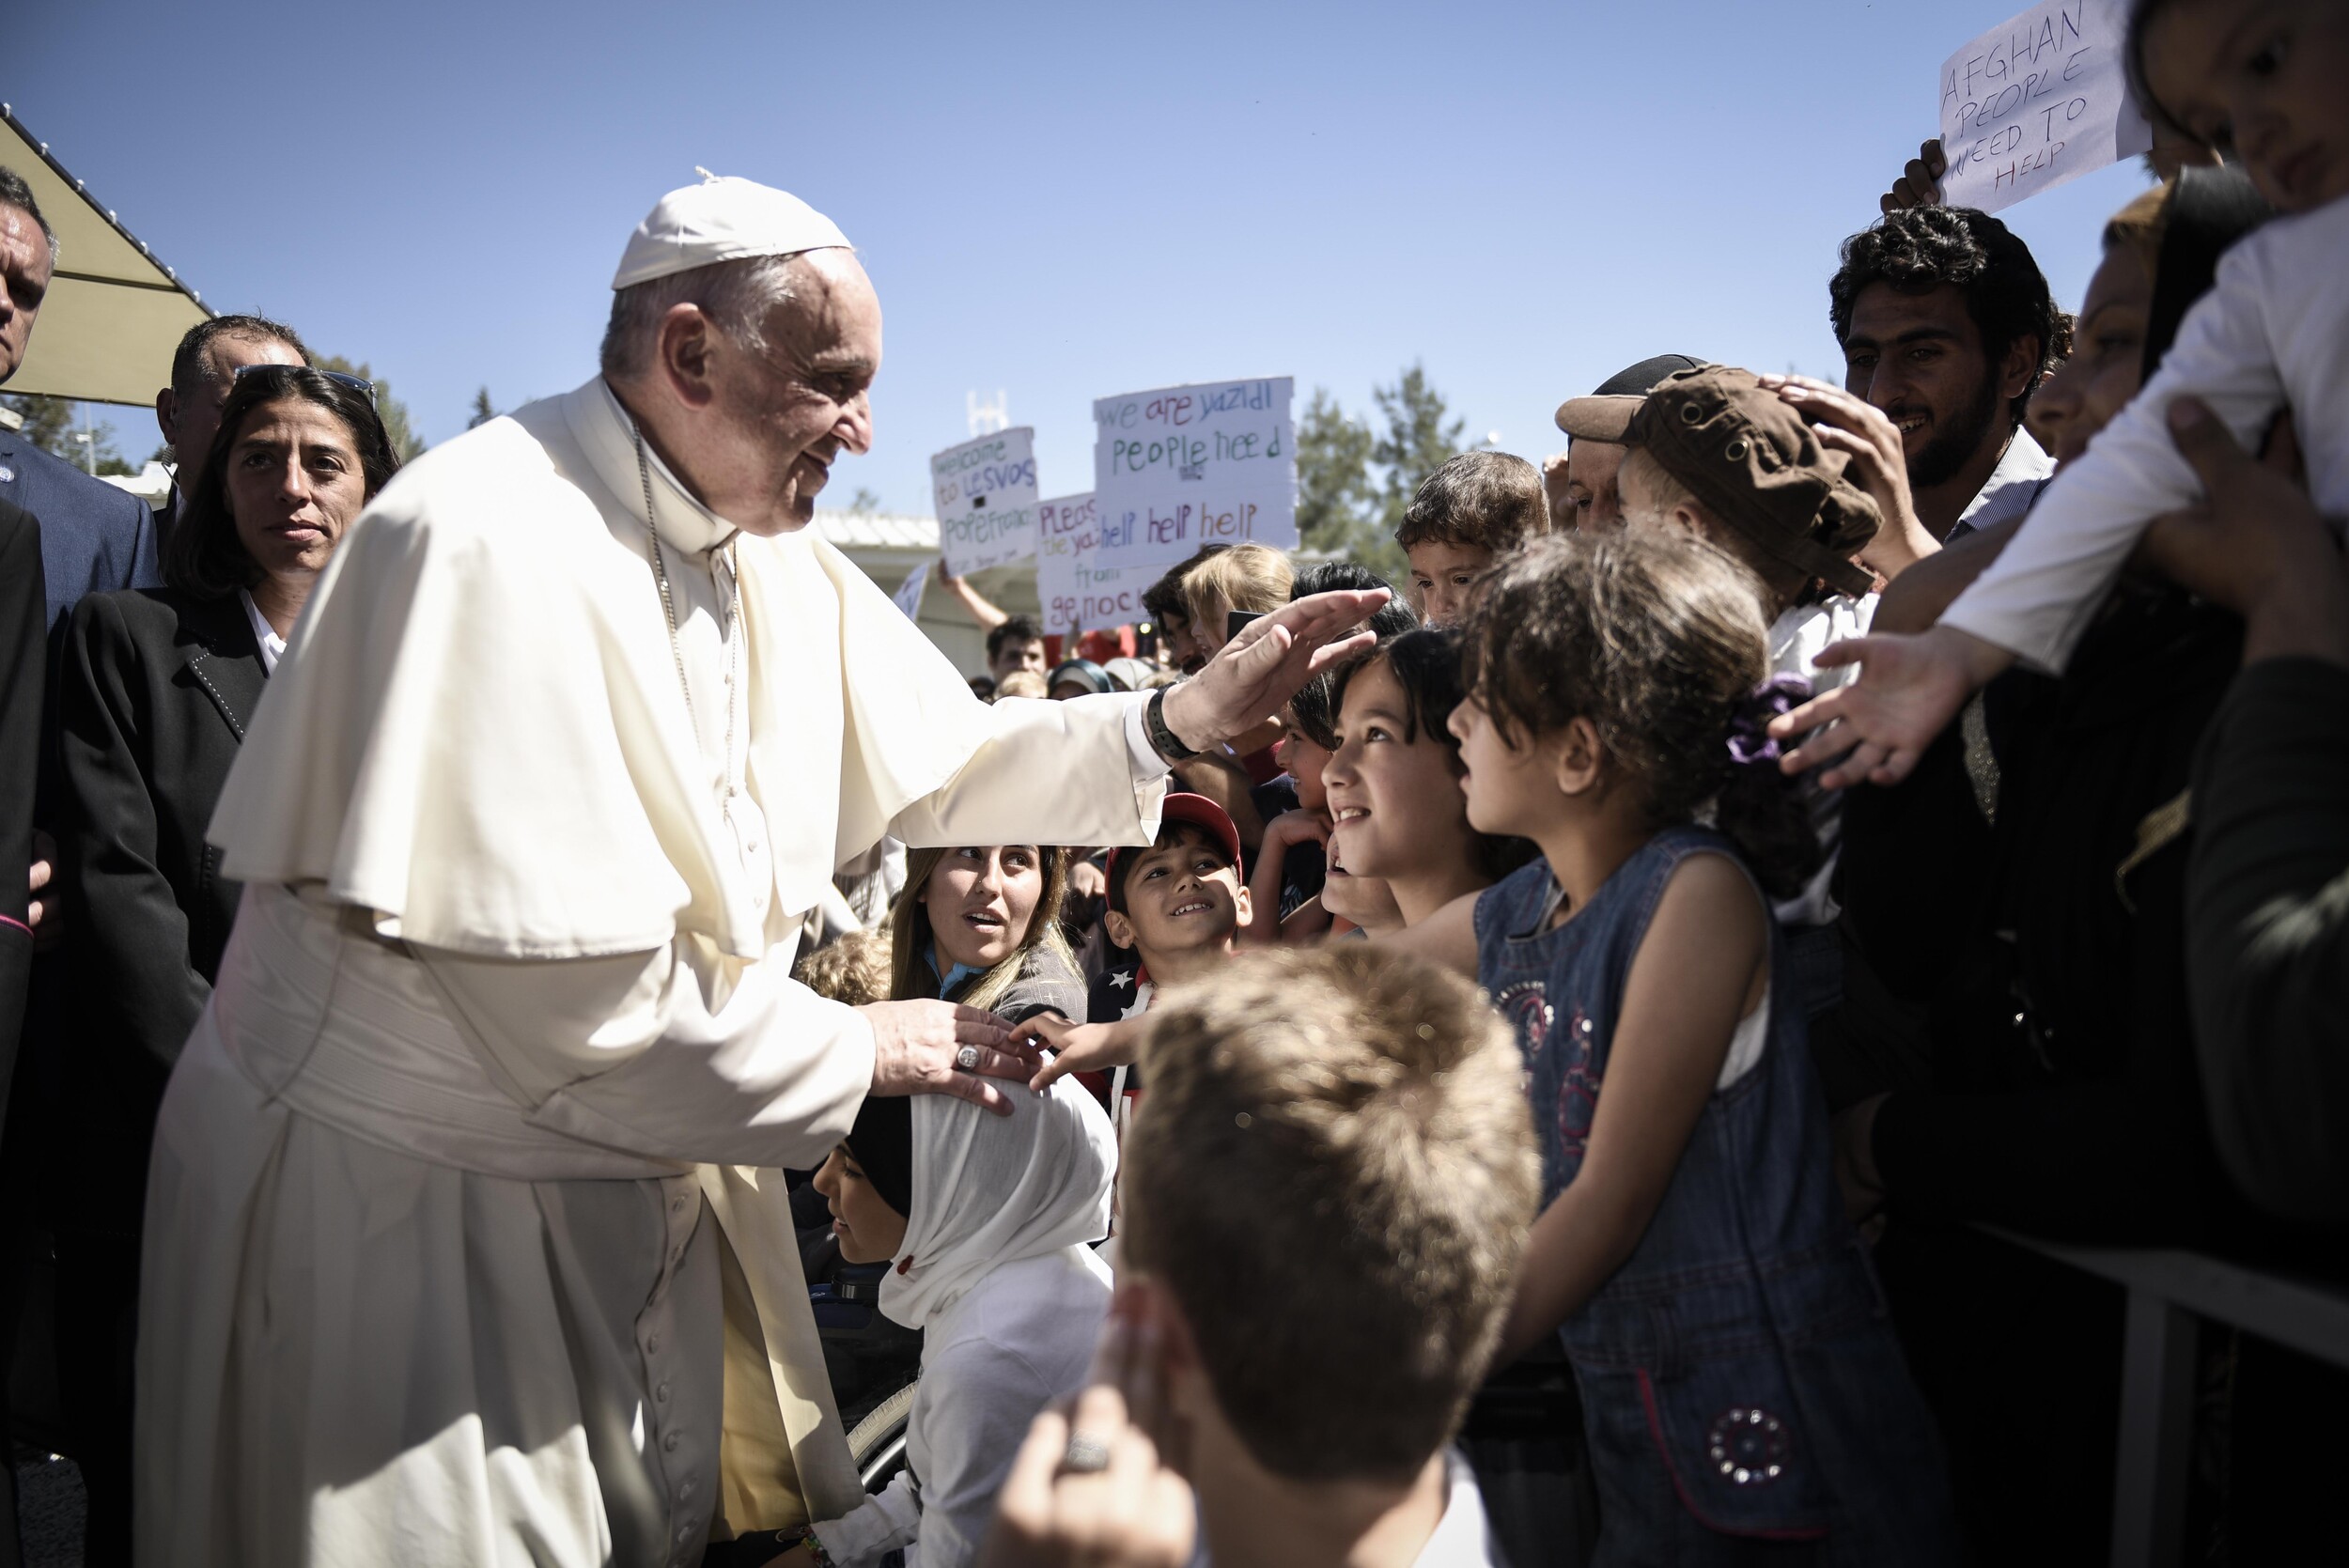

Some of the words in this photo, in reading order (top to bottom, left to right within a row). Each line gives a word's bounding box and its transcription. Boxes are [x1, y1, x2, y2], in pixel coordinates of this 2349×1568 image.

[1941, 0, 2082, 112] AFGHAN
[1954, 45, 2092, 139] PEOPLE
[1950, 125, 2023, 180] NEED
[2039, 97, 2087, 143] TO
[1994, 141, 2065, 194] HELP
[1144, 395, 1193, 426] are
[1213, 425, 1282, 462] need
